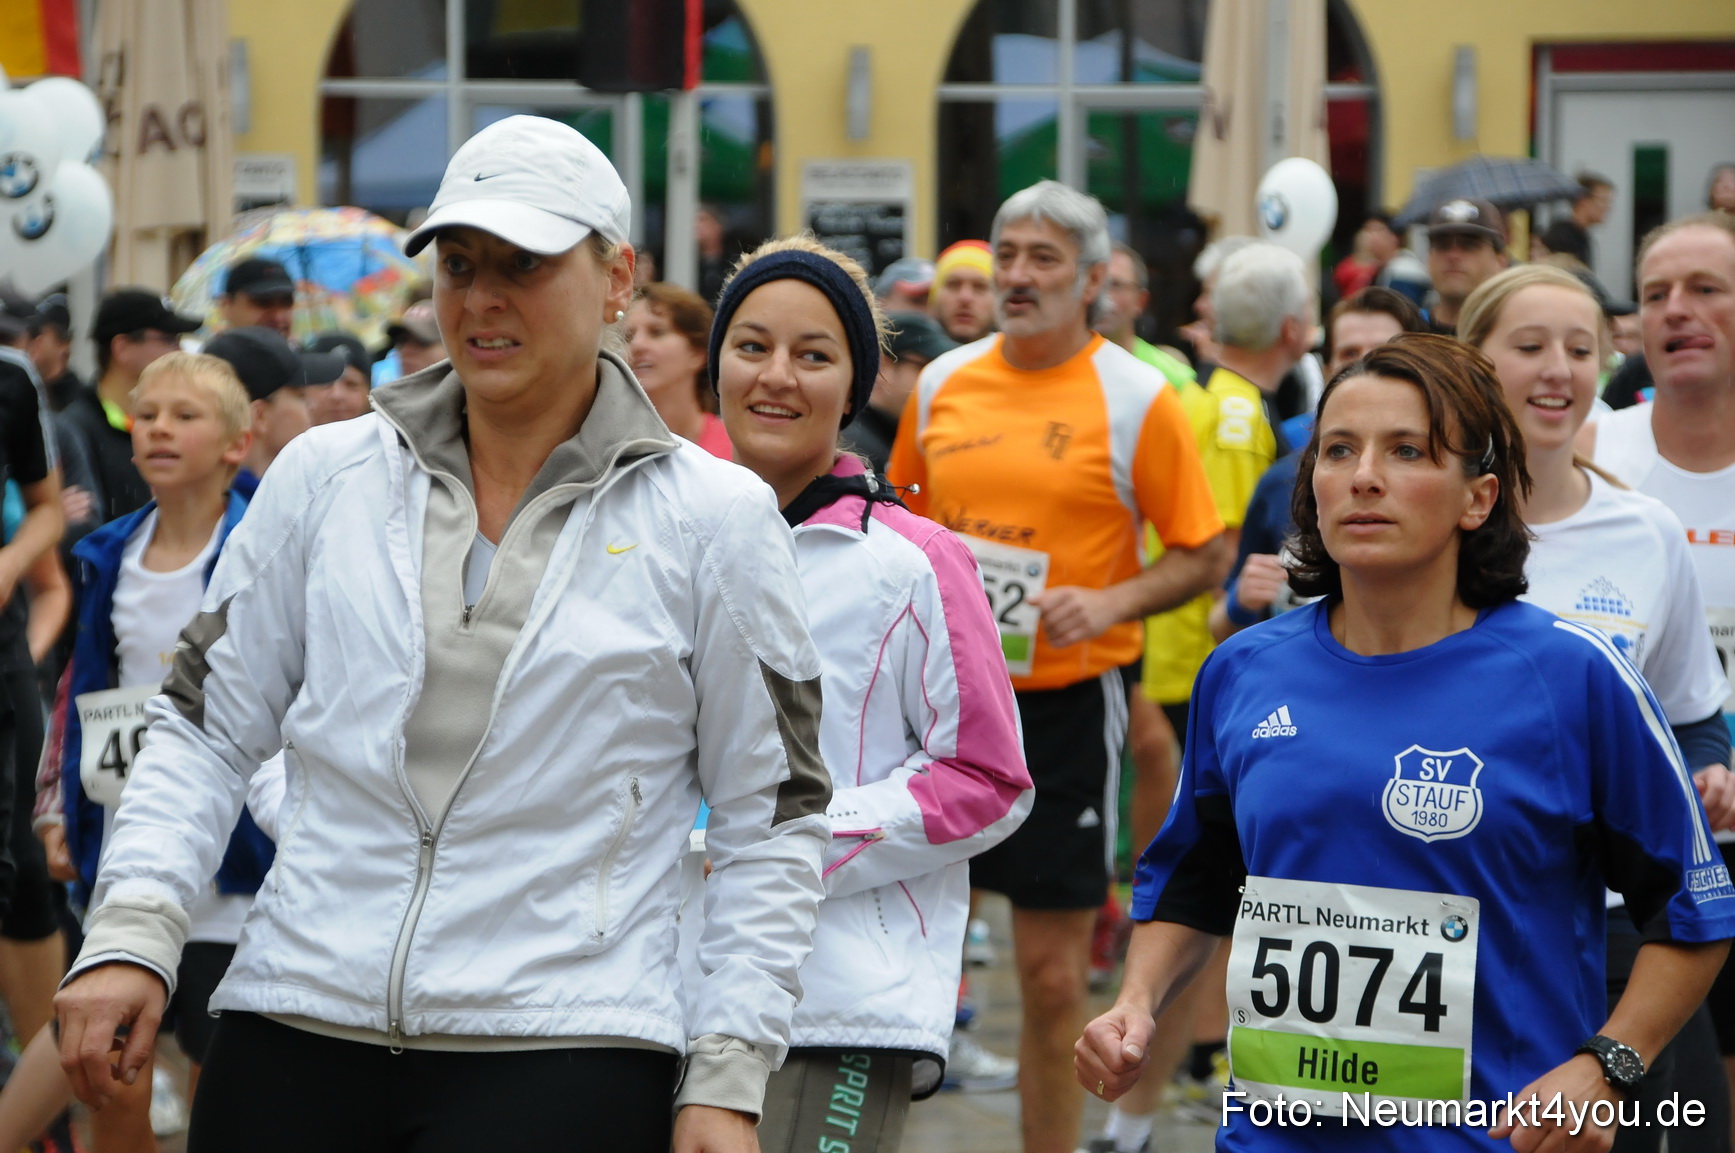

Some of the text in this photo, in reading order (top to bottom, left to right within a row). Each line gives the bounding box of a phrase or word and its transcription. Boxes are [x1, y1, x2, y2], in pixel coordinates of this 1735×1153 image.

[83, 704, 132, 723] PARTL
[1252, 724, 1298, 739] adidas
[1419, 757, 1452, 782] SV
[1396, 783, 1469, 812] STAUF
[1411, 810, 1448, 828] 1980
[1241, 900, 1430, 936] PARTL Neumarkt
[1250, 936, 1448, 1033] 5074
[1297, 1046, 1379, 1086] Hilde
